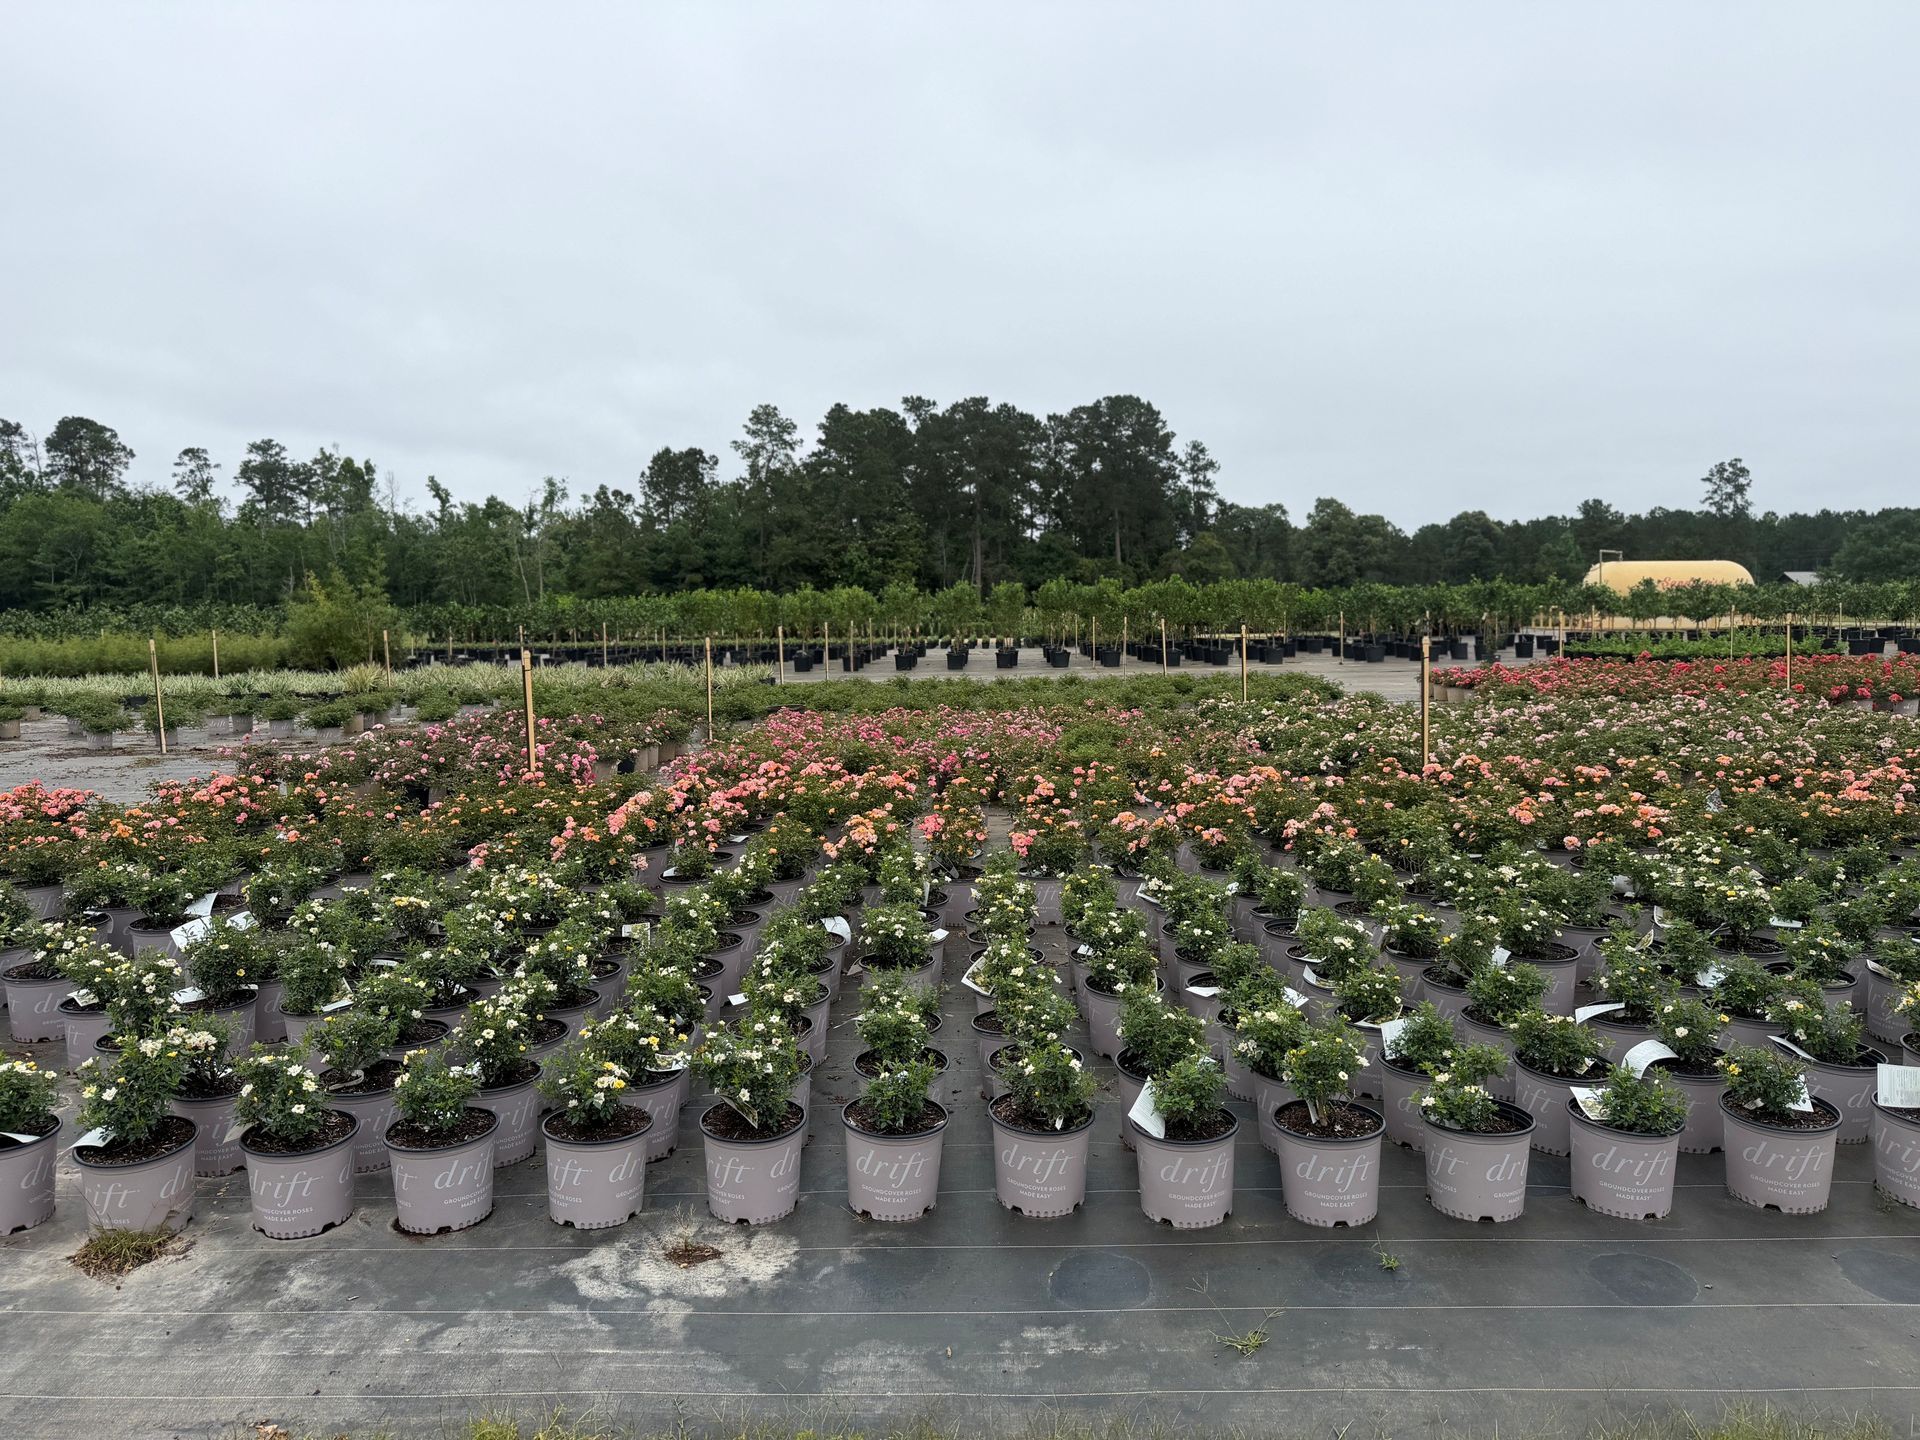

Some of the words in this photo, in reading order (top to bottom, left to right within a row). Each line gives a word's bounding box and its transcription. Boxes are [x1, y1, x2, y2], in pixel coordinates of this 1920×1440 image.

[1001, 1143, 1077, 1184] drift
[1591, 1146, 1674, 1186] drift
[1742, 1141, 1832, 1181] drift
[855, 1150, 930, 1189] drift
[1160, 1152, 1231, 1193] drift
[1296, 1154, 1375, 1193] drift
[1007, 1177, 1048, 1192] GROUNDCOVER
[1599, 1180, 1648, 1193] GROUNDCOVER
[1750, 1173, 1802, 1189] GROUNDCOVER
[1802, 1181, 1820, 1189] ROSES
[861, 1184, 904, 1196] GROUNDCOVER
[905, 1188, 921, 1196] ROSES
[1019, 1190, 1035, 1198] MADE
[1168, 1193, 1213, 1202] GROUNDCOVER
[1304, 1190, 1350, 1201] GROUNDCOVER
[1351, 1192, 1368, 1200] ROSES
[1616, 1192, 1634, 1200] MADE
[1768, 1186, 1787, 1194] MADE
